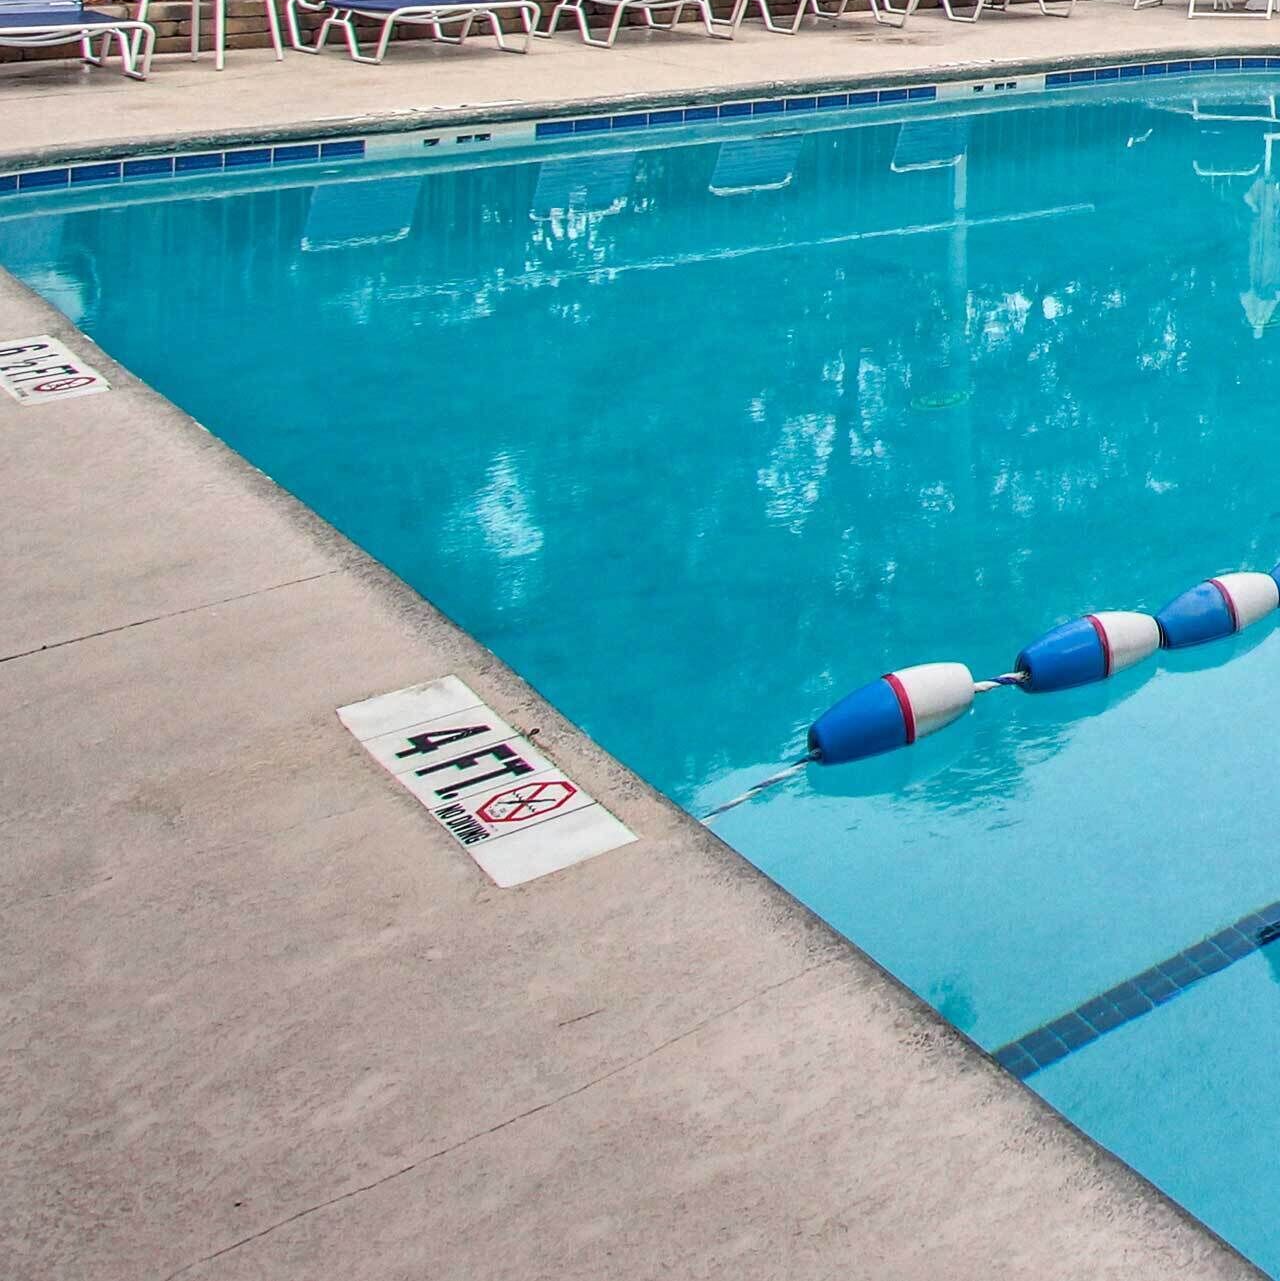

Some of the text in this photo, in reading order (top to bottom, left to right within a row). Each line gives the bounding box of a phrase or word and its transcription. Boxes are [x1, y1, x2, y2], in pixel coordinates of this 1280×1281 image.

[394, 724, 492, 760] 4
[434, 802, 491, 845] NO DIVING
